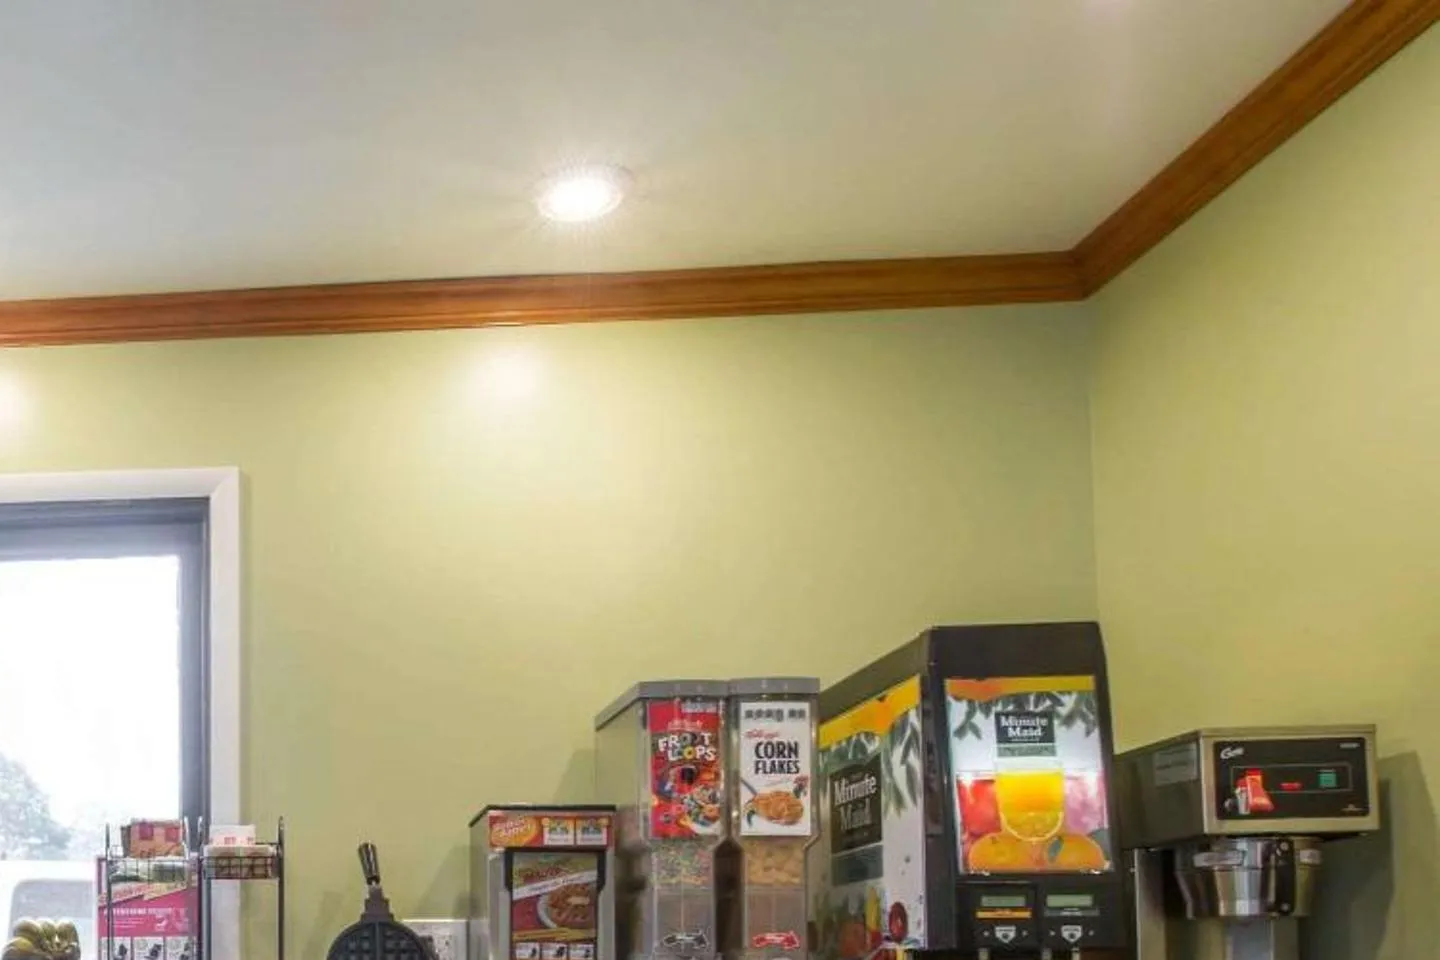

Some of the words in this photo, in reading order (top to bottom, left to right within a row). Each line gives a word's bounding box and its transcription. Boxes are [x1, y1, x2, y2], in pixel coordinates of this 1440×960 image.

[1000, 715, 1049, 728] Minute
[1007, 726, 1042, 738] Maid
[754, 740, 800, 760] CORN
[754, 759, 801, 776] FLAKES
[833, 772, 878, 807] Minute
[840, 797, 873, 834] Maid
